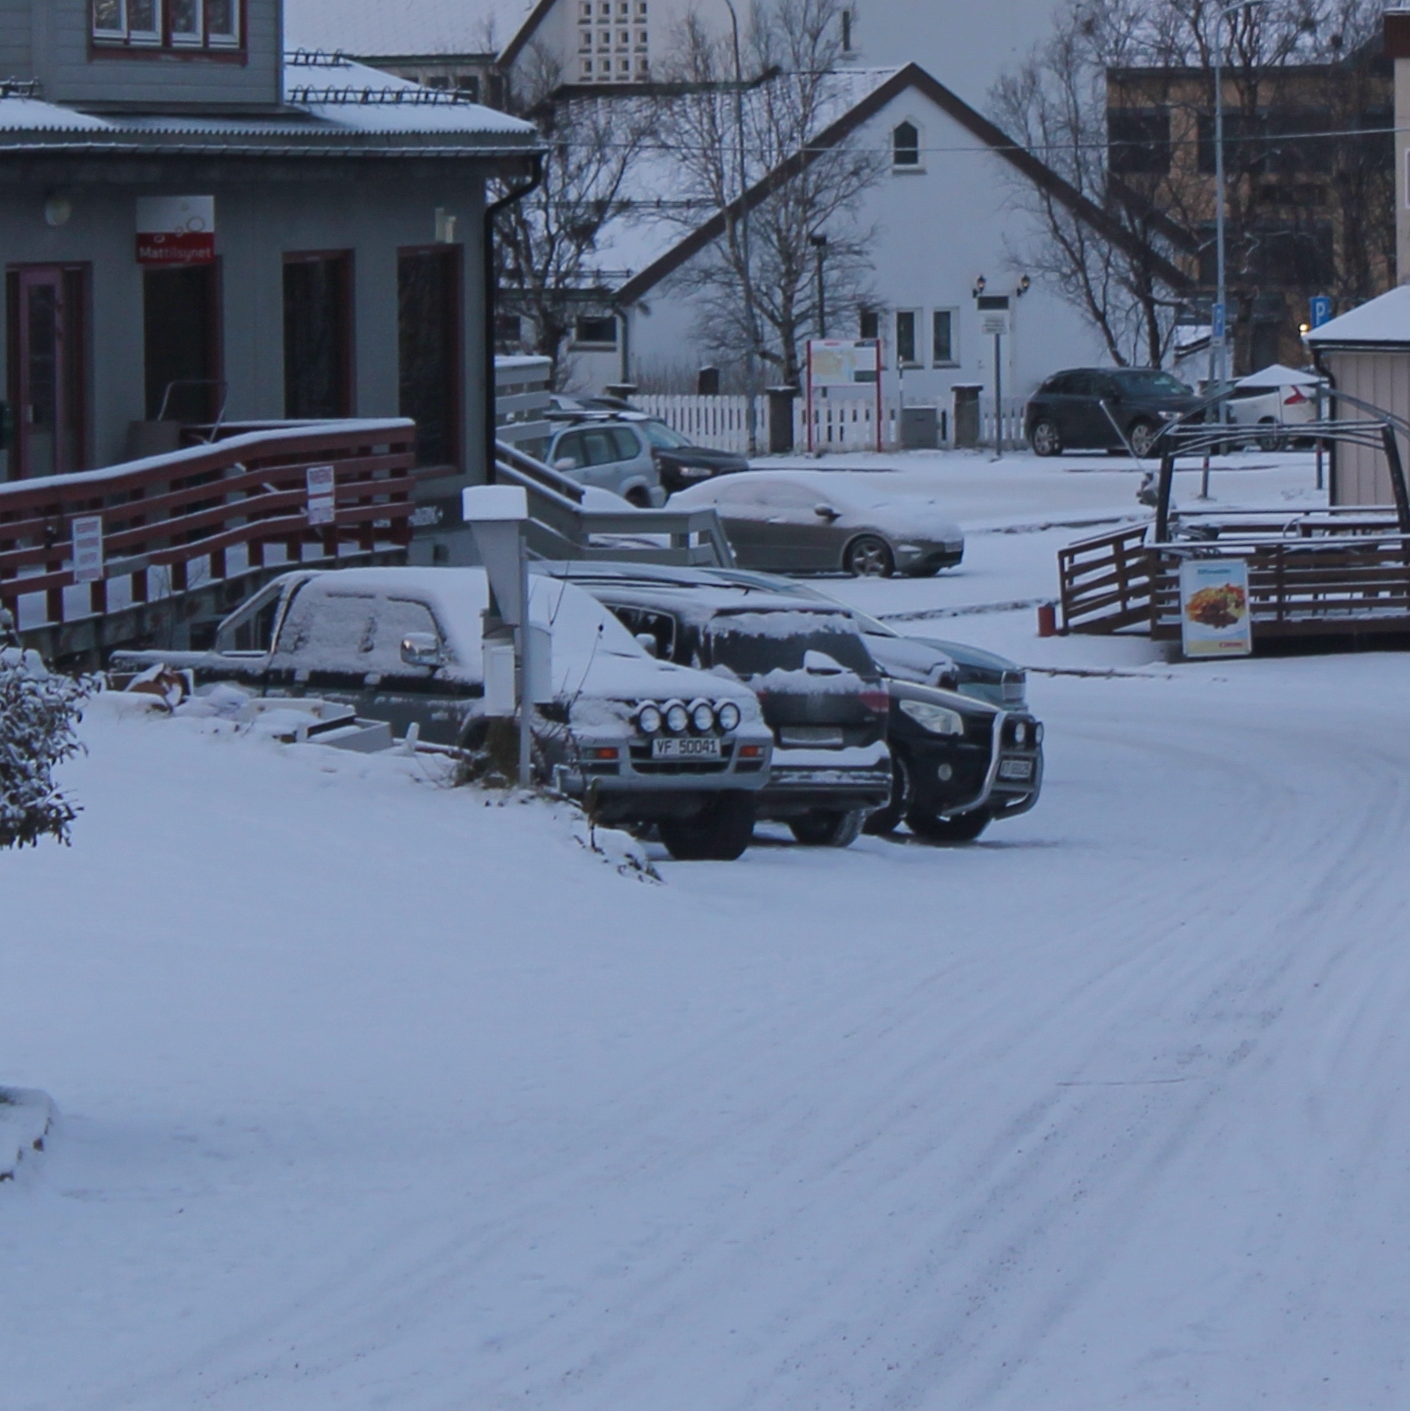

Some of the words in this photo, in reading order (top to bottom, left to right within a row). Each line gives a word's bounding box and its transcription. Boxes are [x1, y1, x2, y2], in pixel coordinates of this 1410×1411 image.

[139, 246, 212, 262] Mattilsynet
[1315, 301, 1326, 326] P
[657, 740, 673, 754] VF
[678, 739, 718, 754] 50041
